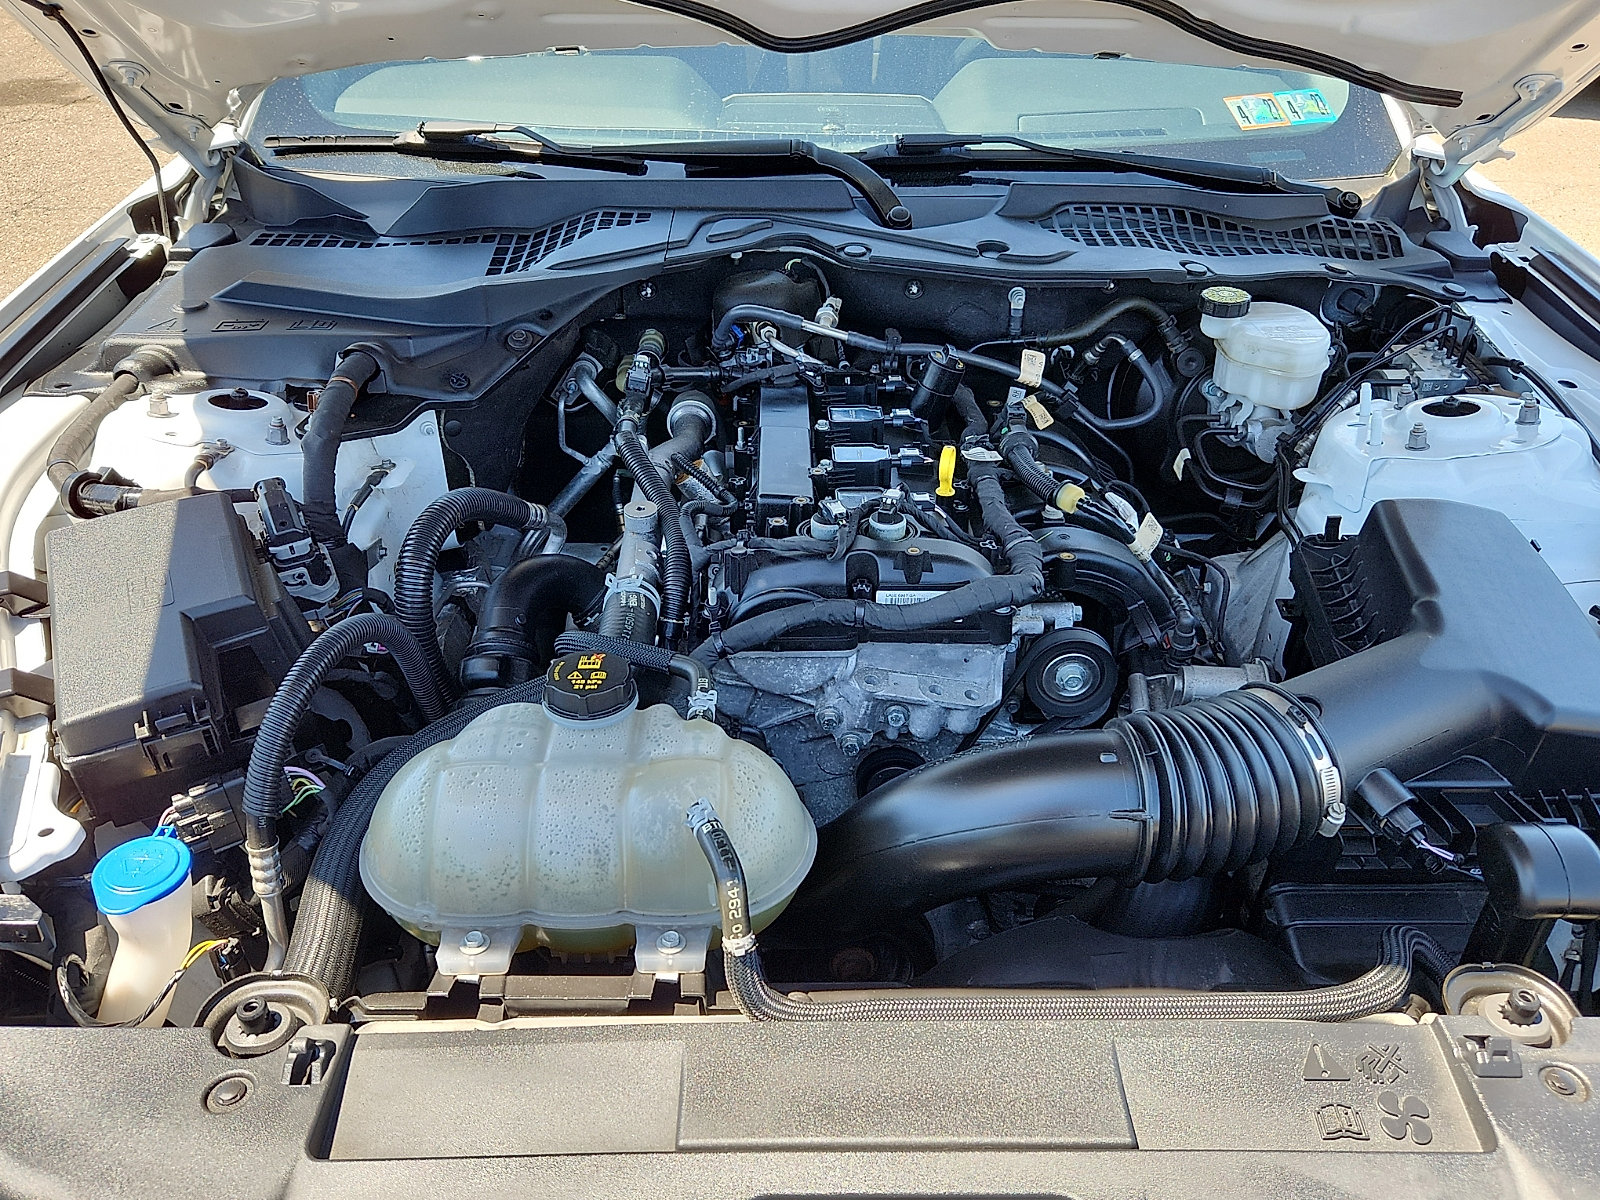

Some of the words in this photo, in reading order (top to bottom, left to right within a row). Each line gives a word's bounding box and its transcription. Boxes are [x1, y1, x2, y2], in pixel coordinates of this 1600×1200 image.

[1236, 105, 1252, 124] 4
[1287, 100, 1302, 120] 4
[726, 877, 742, 920] 2941
